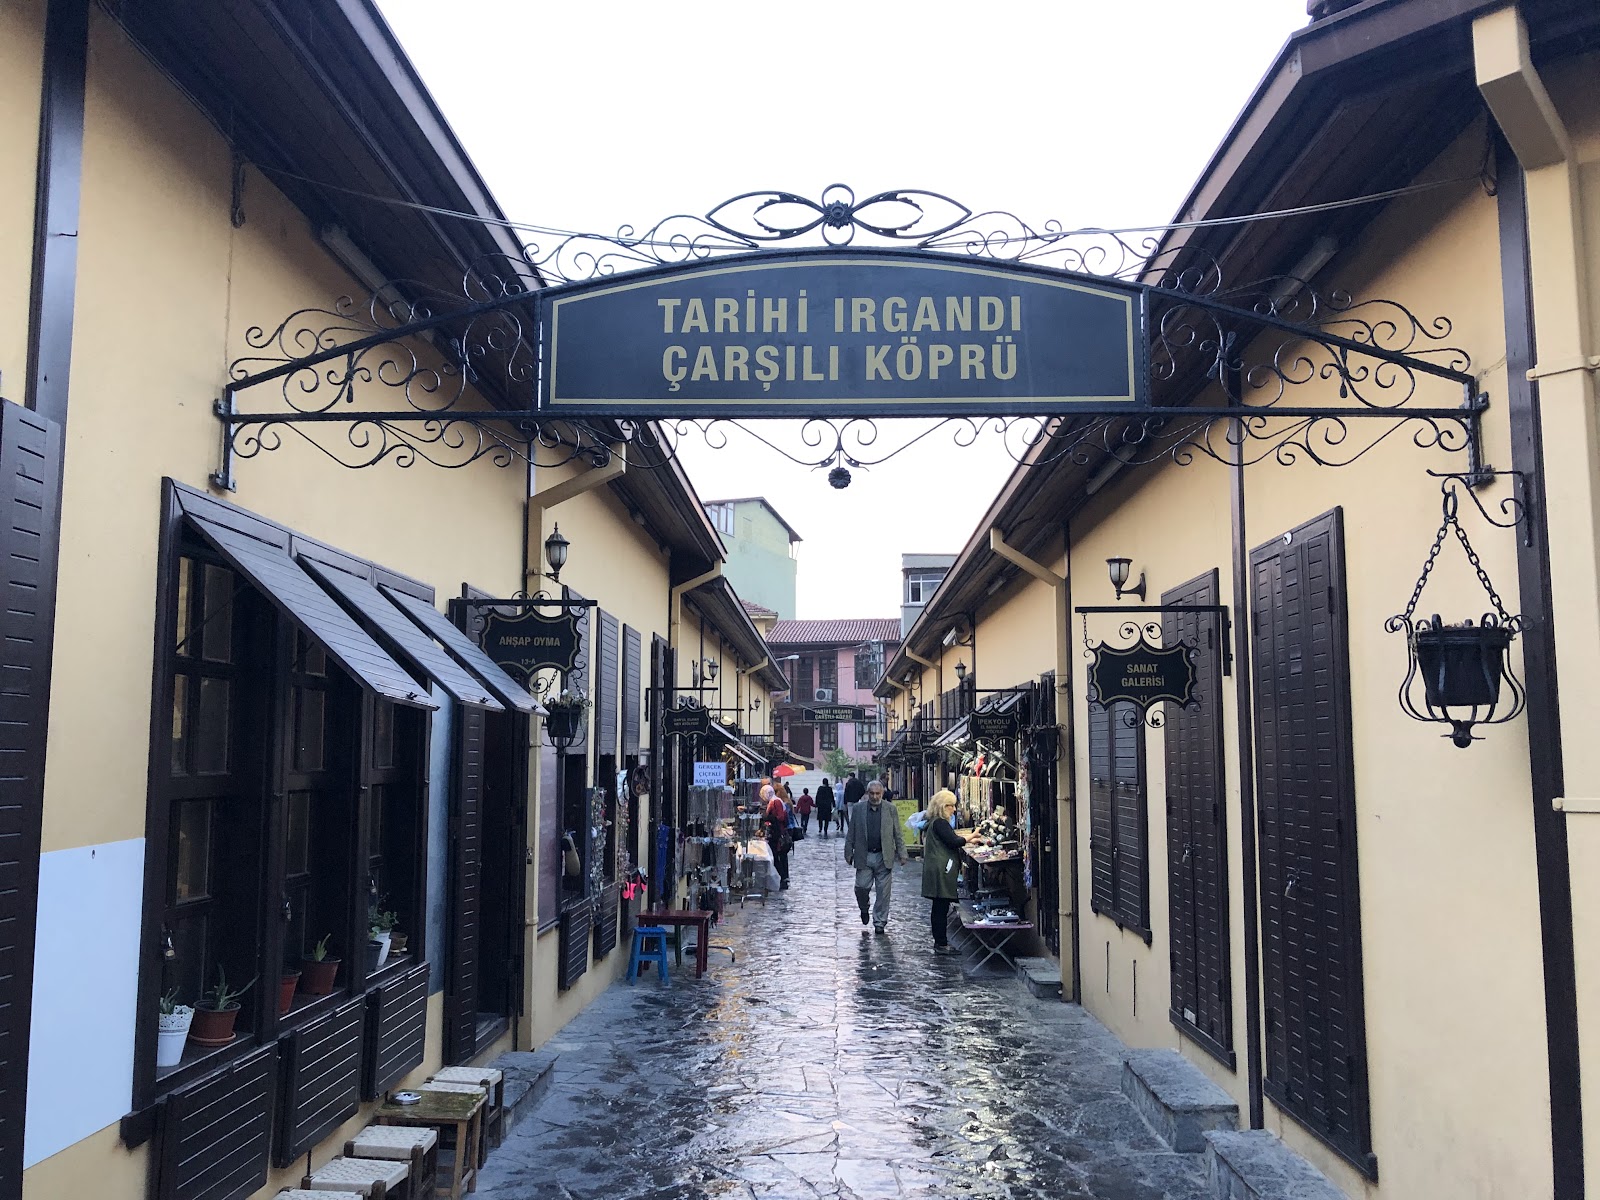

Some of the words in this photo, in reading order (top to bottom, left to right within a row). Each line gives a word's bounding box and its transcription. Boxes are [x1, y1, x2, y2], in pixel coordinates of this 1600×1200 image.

[658, 290, 809, 333] TARİHİ
[834, 295, 1021, 332] IRGANDI
[662, 345, 840, 392] ÇARŞILI
[865, 335, 1018, 381] KÖPRÜ
[499, 636, 531, 648] AHŞAP
[533, 637, 560, 647] OYMA
[1126, 664, 1158, 674] SANAT
[1121, 675, 1165, 687] GALERİSİ
[977, 717, 1011, 725] İPEKYOLU
